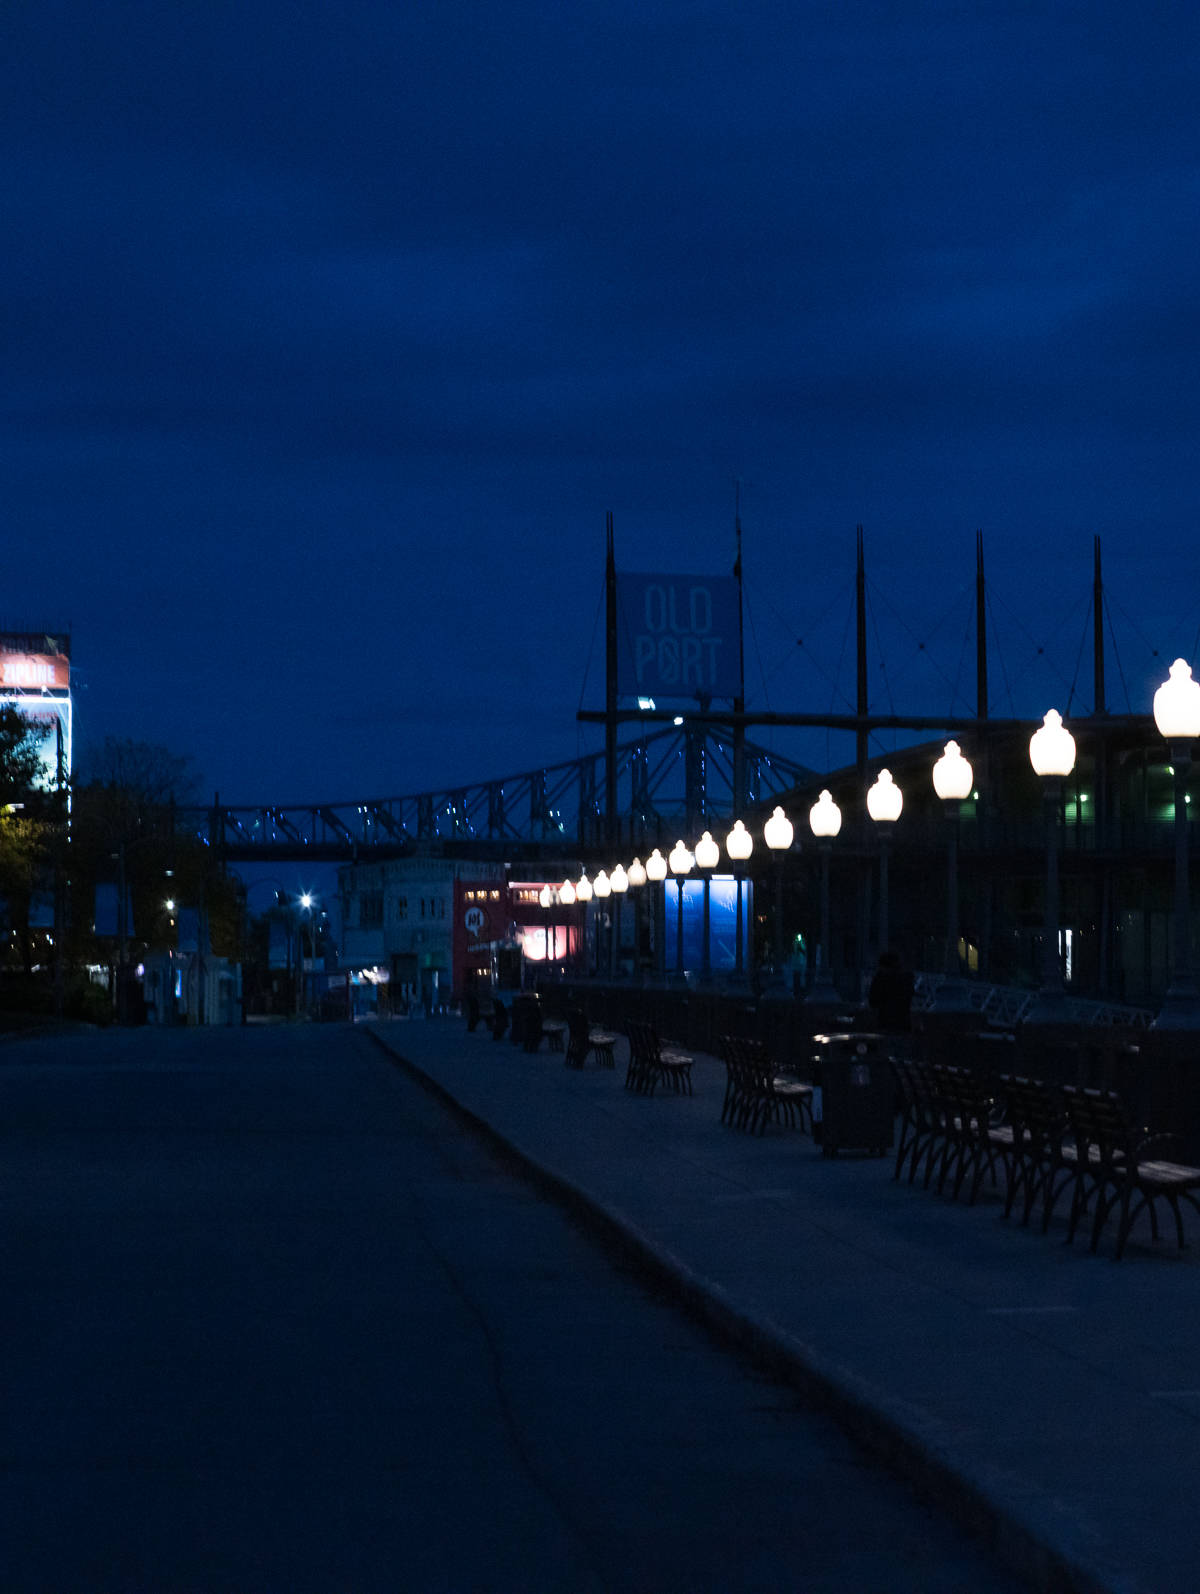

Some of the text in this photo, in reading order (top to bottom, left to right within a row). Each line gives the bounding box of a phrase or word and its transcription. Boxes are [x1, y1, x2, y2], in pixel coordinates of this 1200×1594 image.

[645, 585, 712, 634] OLD
[3, 663, 56, 684] ZIPLINE
[636, 635, 722, 685] PORT
